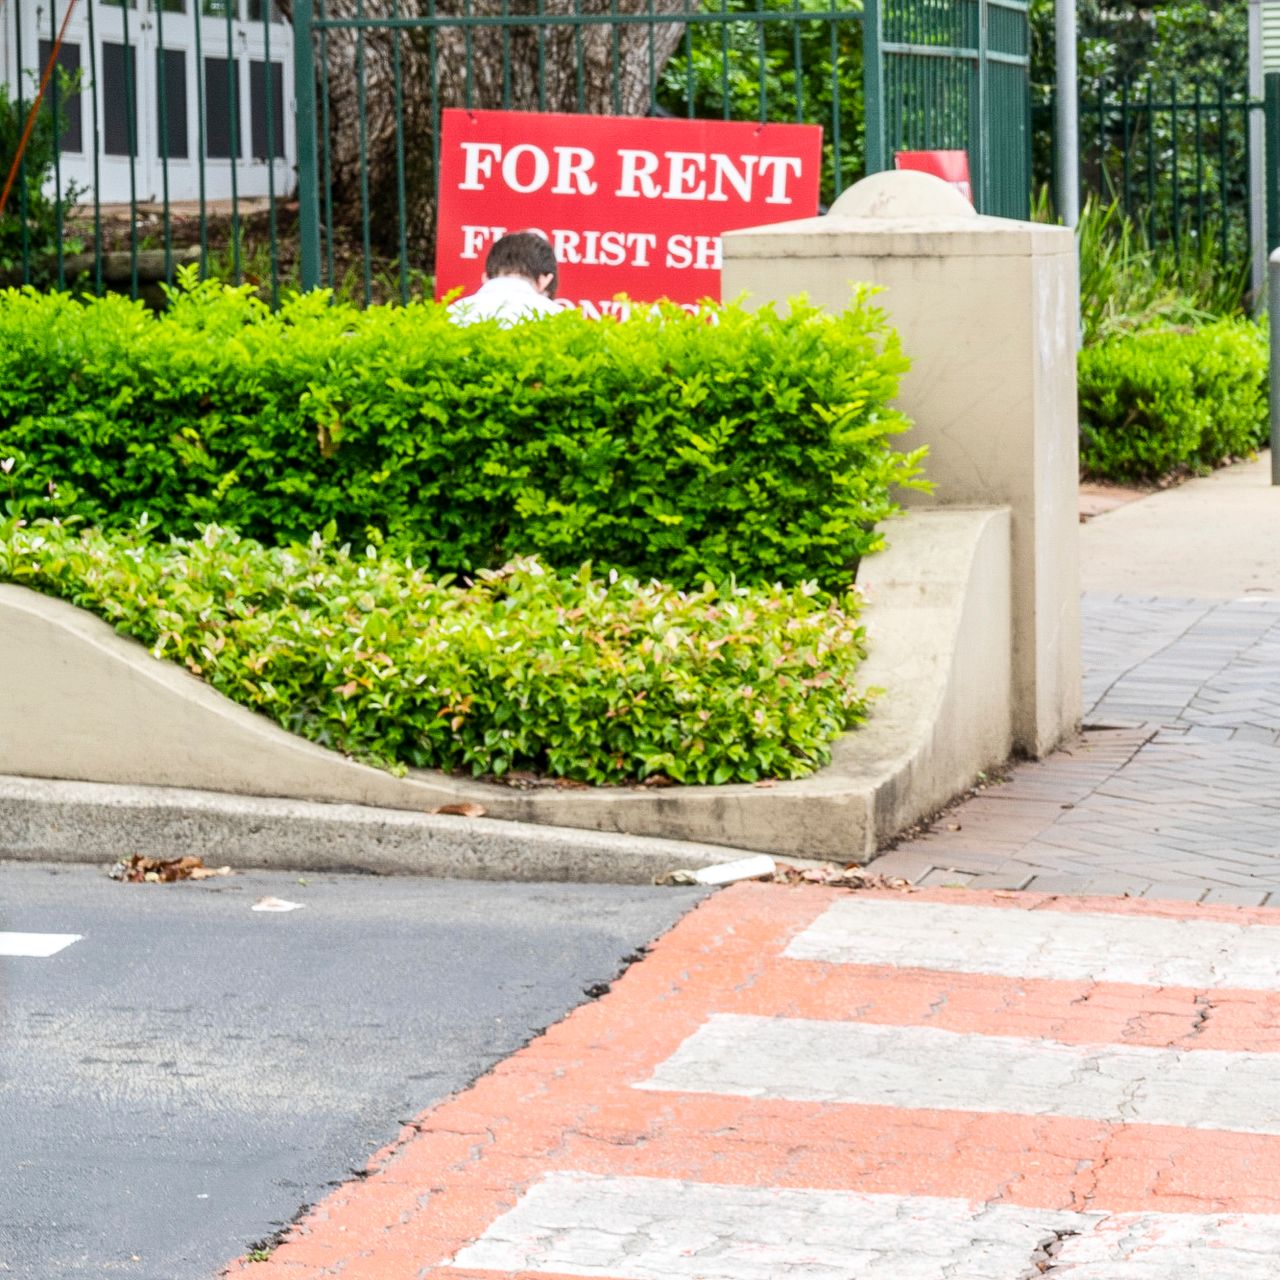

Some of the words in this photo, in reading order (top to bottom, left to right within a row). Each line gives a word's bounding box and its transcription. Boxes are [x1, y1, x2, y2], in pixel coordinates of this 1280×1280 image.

[458, 142, 597, 196] FOR
[615, 149, 802, 205] RENT
[460, 225, 656, 267] FRIST
